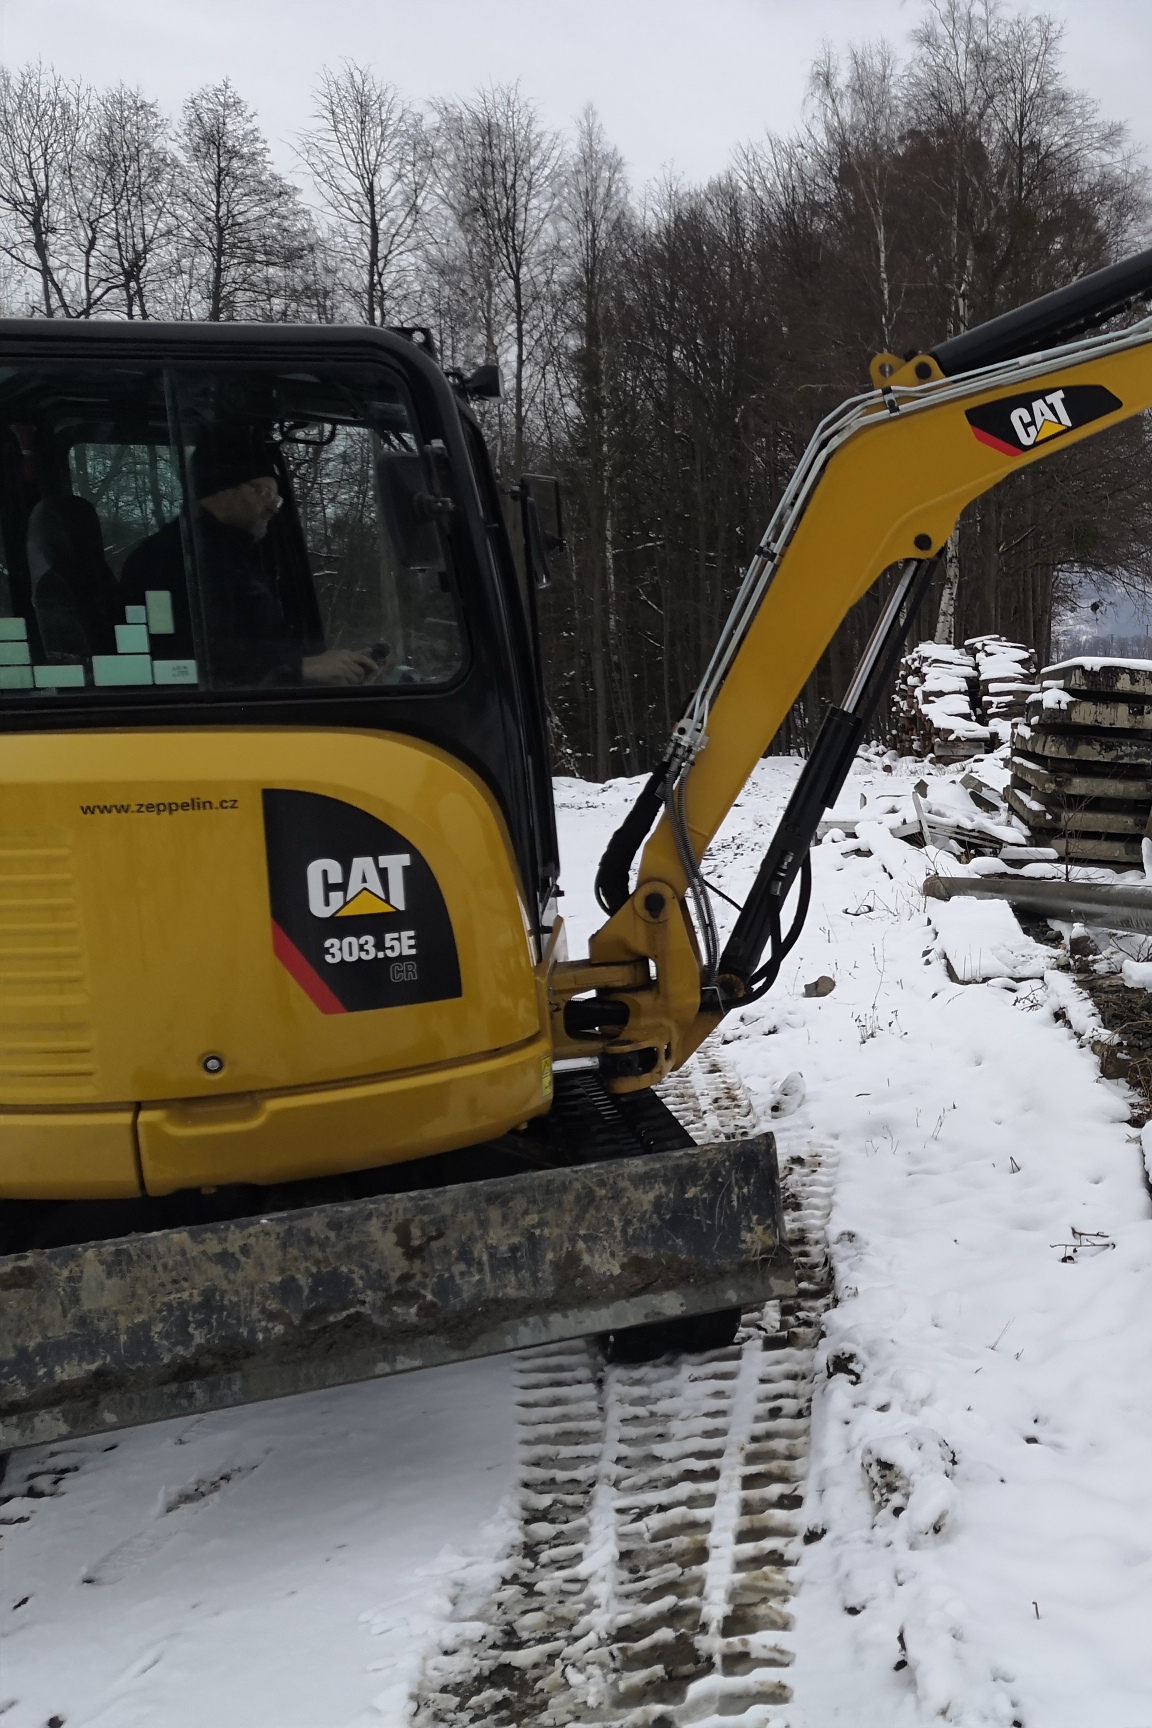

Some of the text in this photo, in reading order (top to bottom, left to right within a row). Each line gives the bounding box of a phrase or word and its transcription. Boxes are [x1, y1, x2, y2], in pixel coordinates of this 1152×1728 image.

[1010, 389, 1072, 446] CAT
[80, 797, 239, 816] www.zeppelin.cz
[307, 854, 411, 918] CAT
[324, 931, 417, 964] 303.5E
[390, 961, 418, 983] CR
